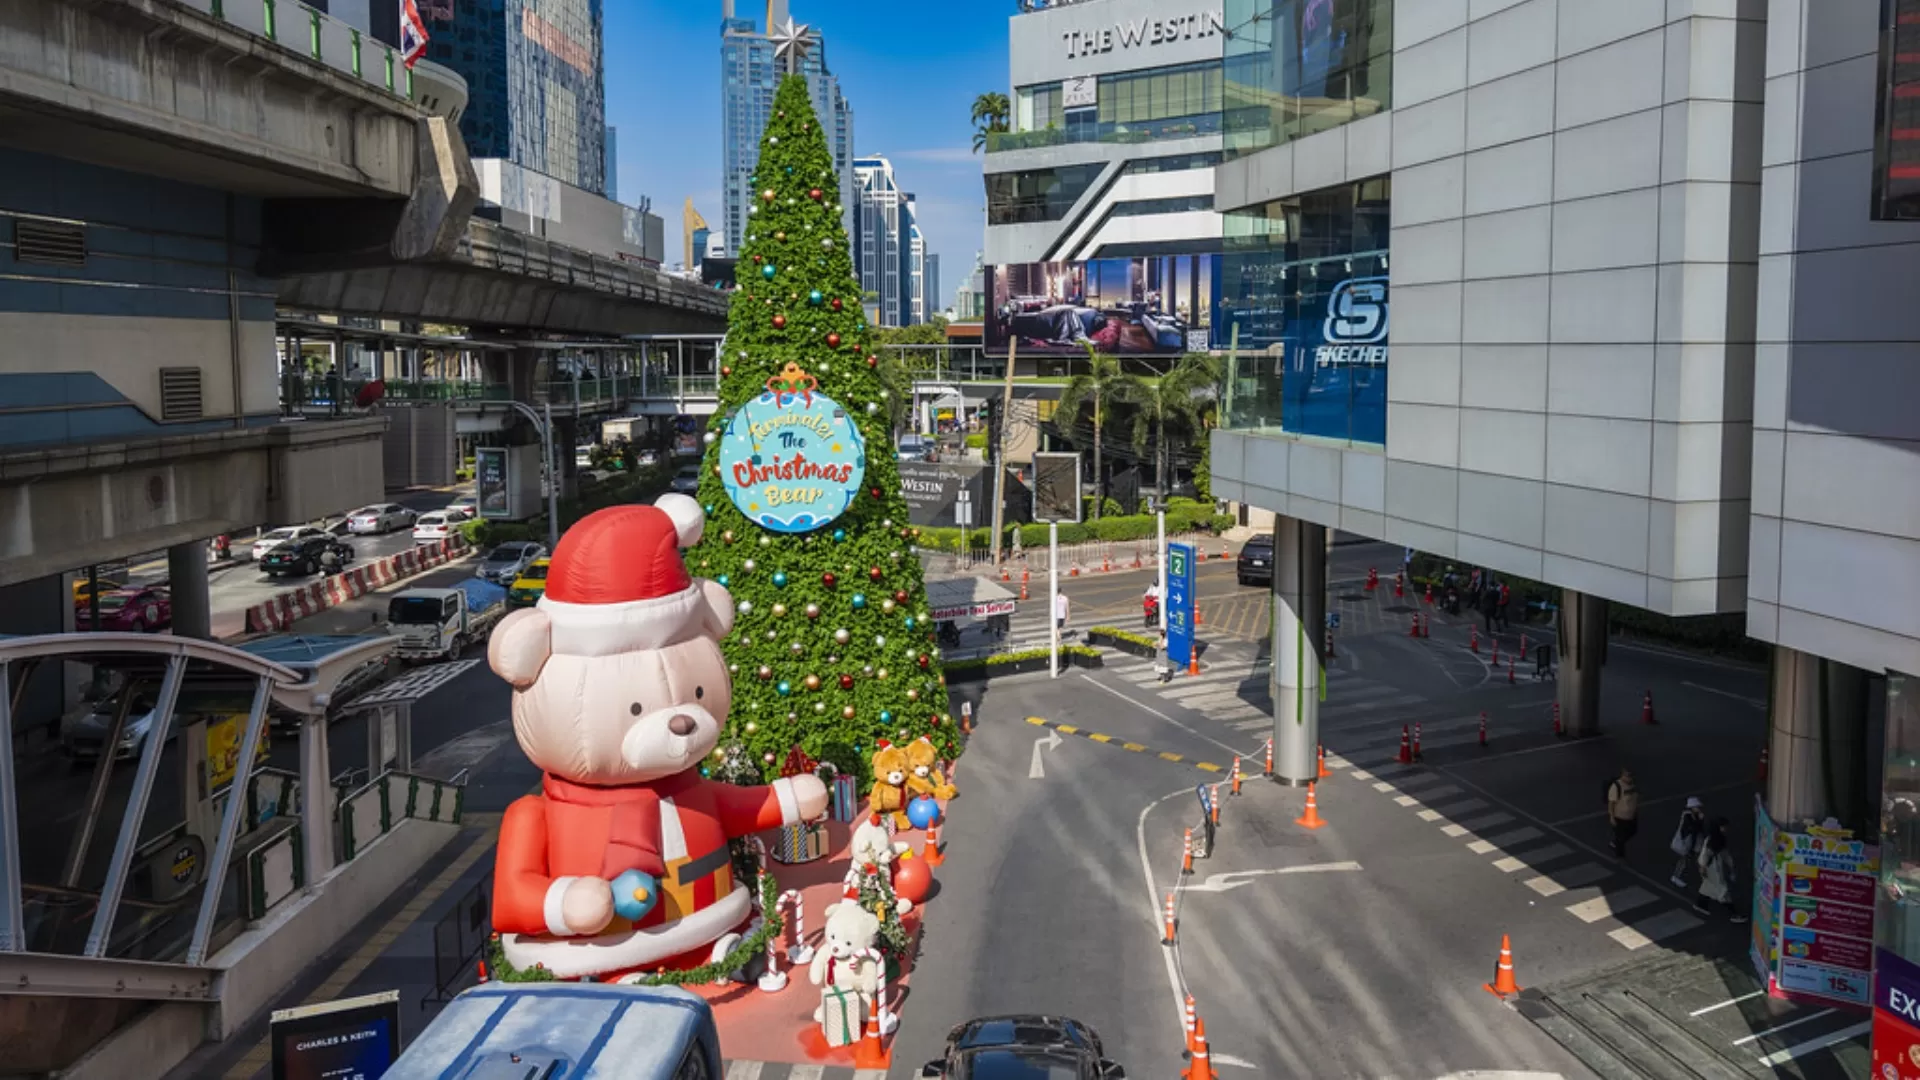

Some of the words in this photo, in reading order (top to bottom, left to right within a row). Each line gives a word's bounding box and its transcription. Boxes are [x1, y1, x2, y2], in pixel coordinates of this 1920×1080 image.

[1063, 29, 1113, 59] THE
[1116, 10, 1223, 49] WESTIN
[778, 432, 806, 449] The
[733, 452, 852, 488] Christmas
[764, 485, 824, 508] Bear
[901, 478, 943, 493] WESTIN
[296, 1036, 339, 1051] CHARLES
[341, 1035, 348, 1043] &
[350, 1029, 378, 1041] KEITH
